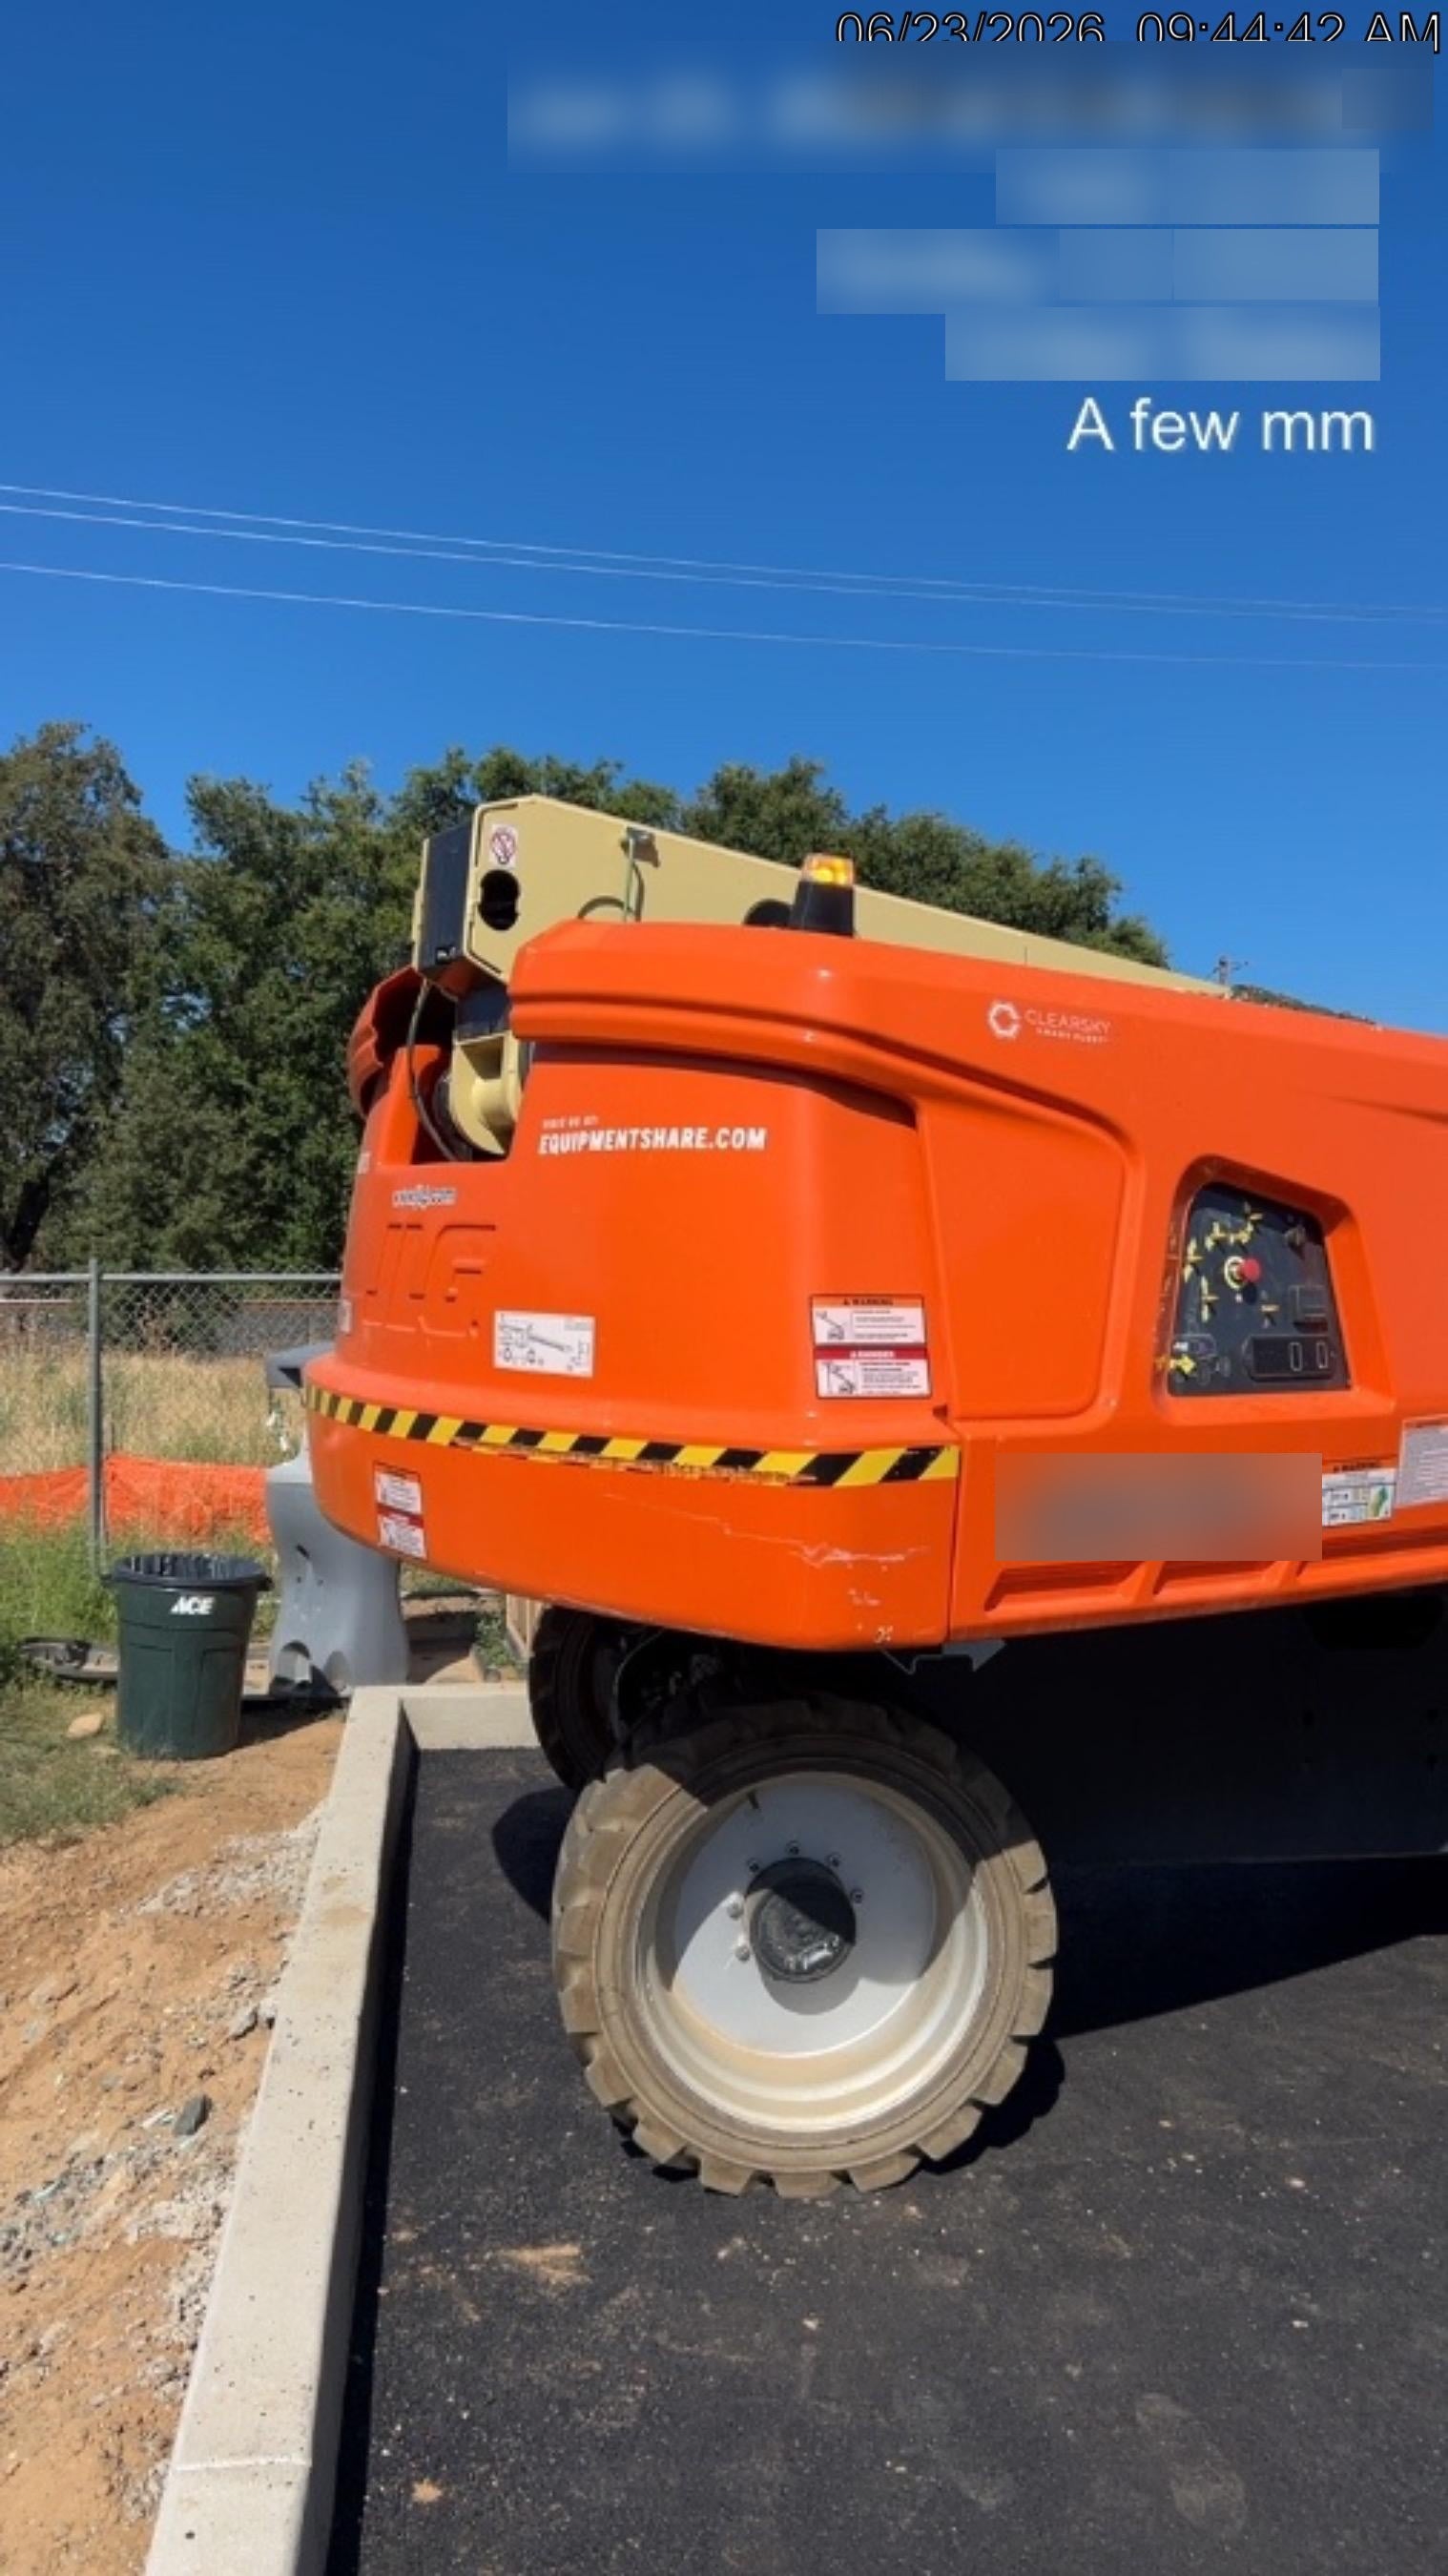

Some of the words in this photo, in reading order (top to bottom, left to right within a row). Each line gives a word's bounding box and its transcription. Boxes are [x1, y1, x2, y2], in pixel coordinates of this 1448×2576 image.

[1024, 1009, 1111, 1034] CLEARSKY
[538, 1127, 767, 1155] EQUIPMENTSHARE.COM
[171, 1596, 215, 1615] ACE
